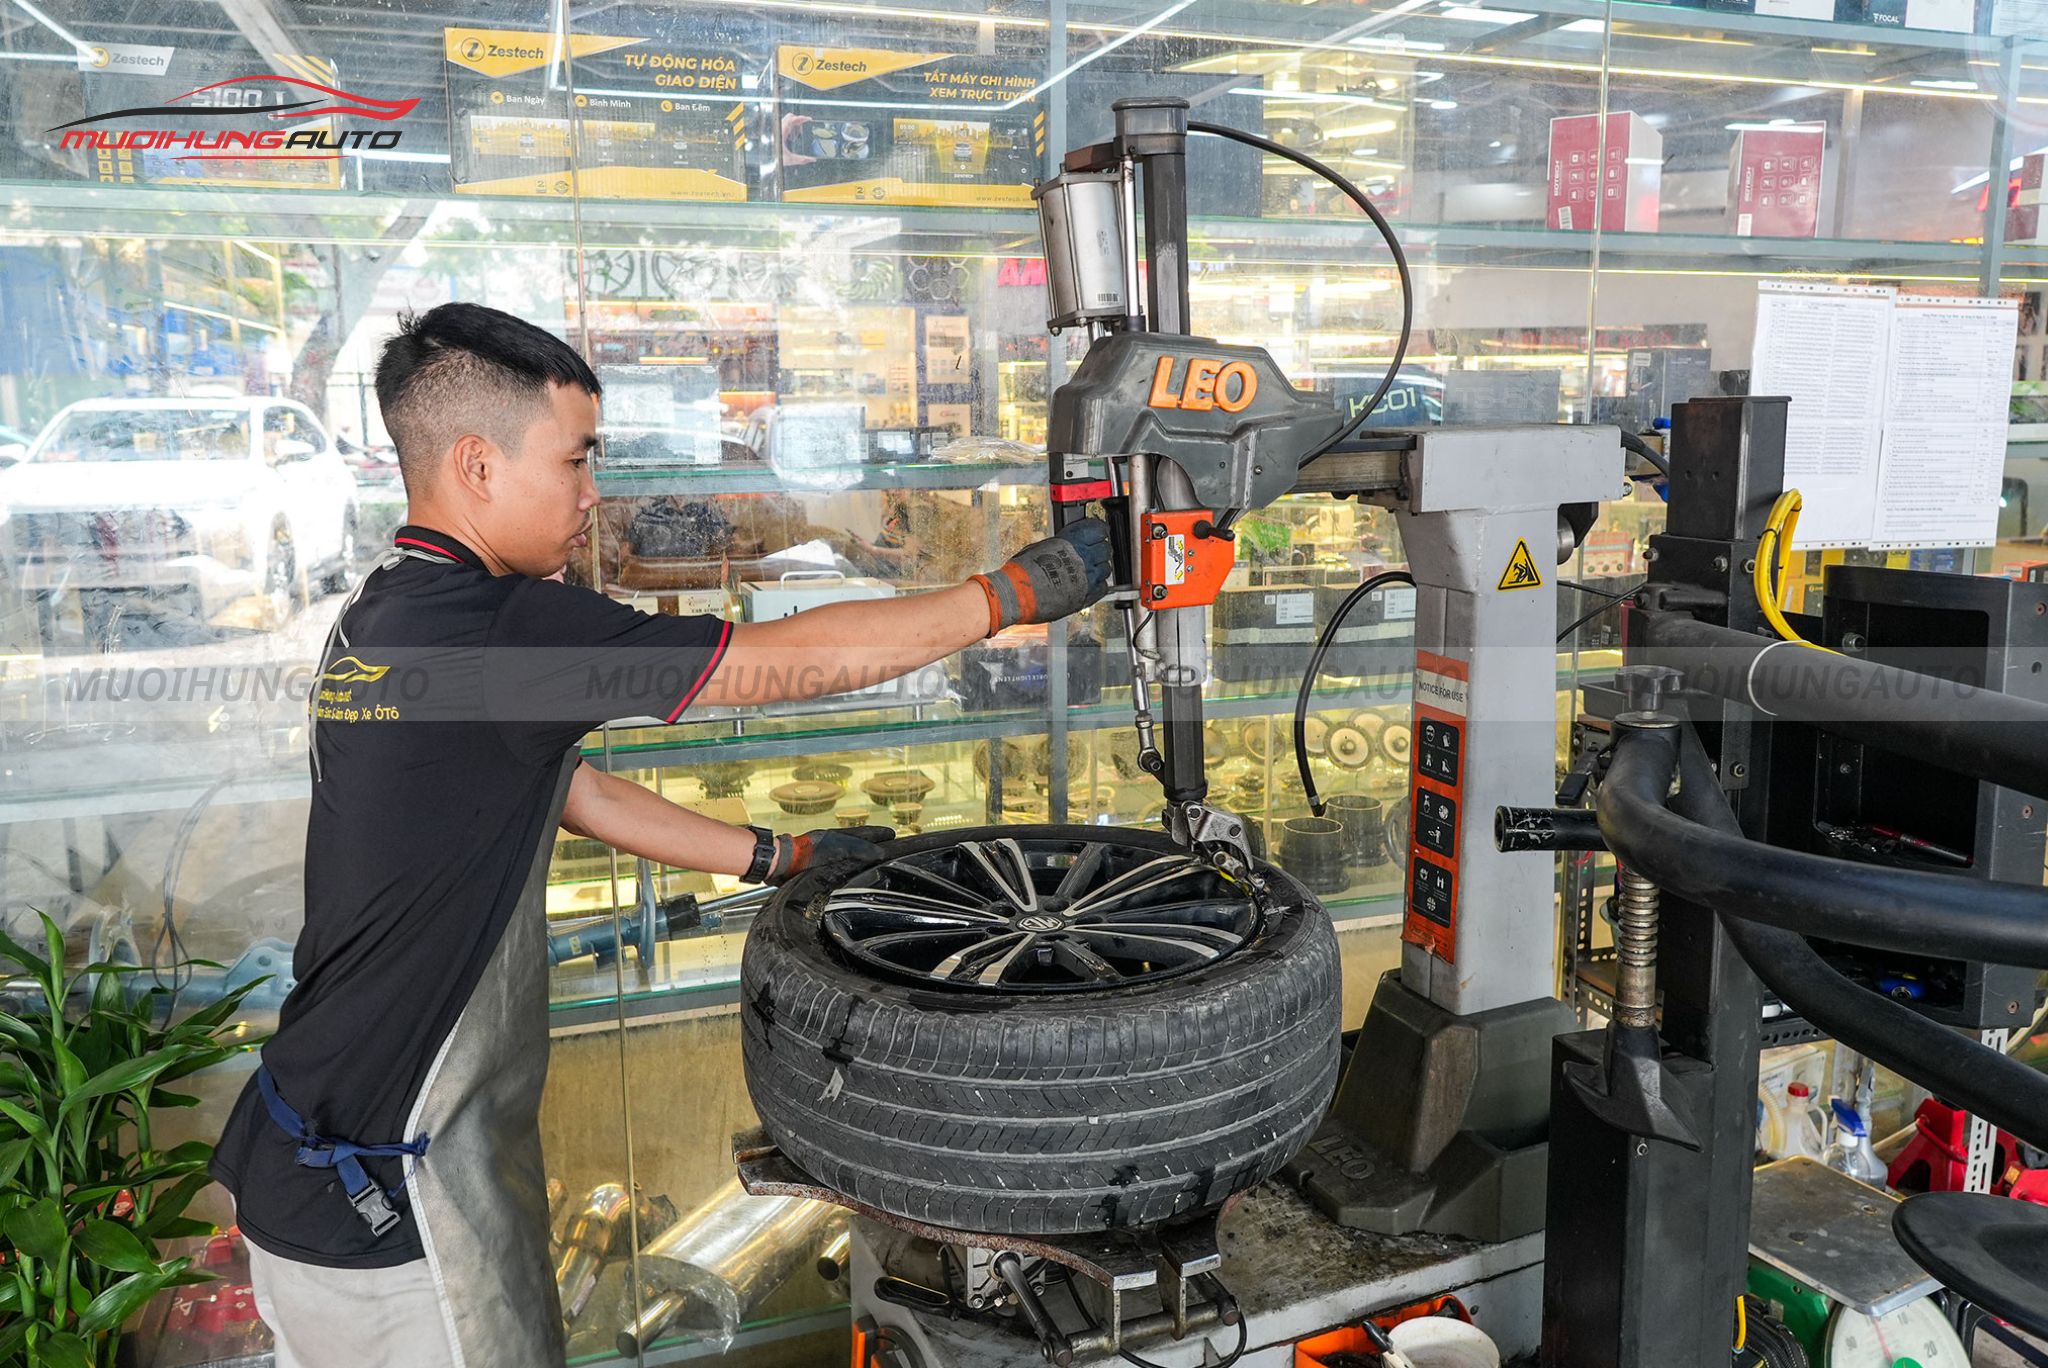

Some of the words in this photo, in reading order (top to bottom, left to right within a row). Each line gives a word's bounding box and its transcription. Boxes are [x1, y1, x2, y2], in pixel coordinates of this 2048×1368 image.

[1879, 14, 1900, 23] FOCAL
[488, 45, 544, 59] Zestech
[112, 53, 164, 67] Zestech
[624, 53, 647, 70] TỰ
[650, 53, 698, 71] ĐỘNG
[701, 55, 736, 72] HÓA
[815, 59, 867, 72] Zestech
[655, 74, 695, 88] GIAO
[699, 75, 737, 92] DIỆN
[950, 72, 978, 85] MÁY
[980, 75, 1001, 87] GHI
[1004, 75, 1036, 88] HÌNH
[506, 94, 523, 103] Ban
[524, 95, 546, 106] Ngày
[929, 87, 957, 99] XEM
[959, 87, 993, 102] TRỰC
[610, 99, 631, 108] Minh
[675, 103, 690, 111] Ban
[1148, 356, 1258, 414] LEO
[1418, 680, 1439, 696] NOTICE
[1440, 687, 1451, 699] FOR
[1452, 690, 1464, 702] USE
[361, 707, 372, 720] Xe
[1307, 1134, 1376, 1179] LEO
[1924, 1340, 1938, 1358] 20
